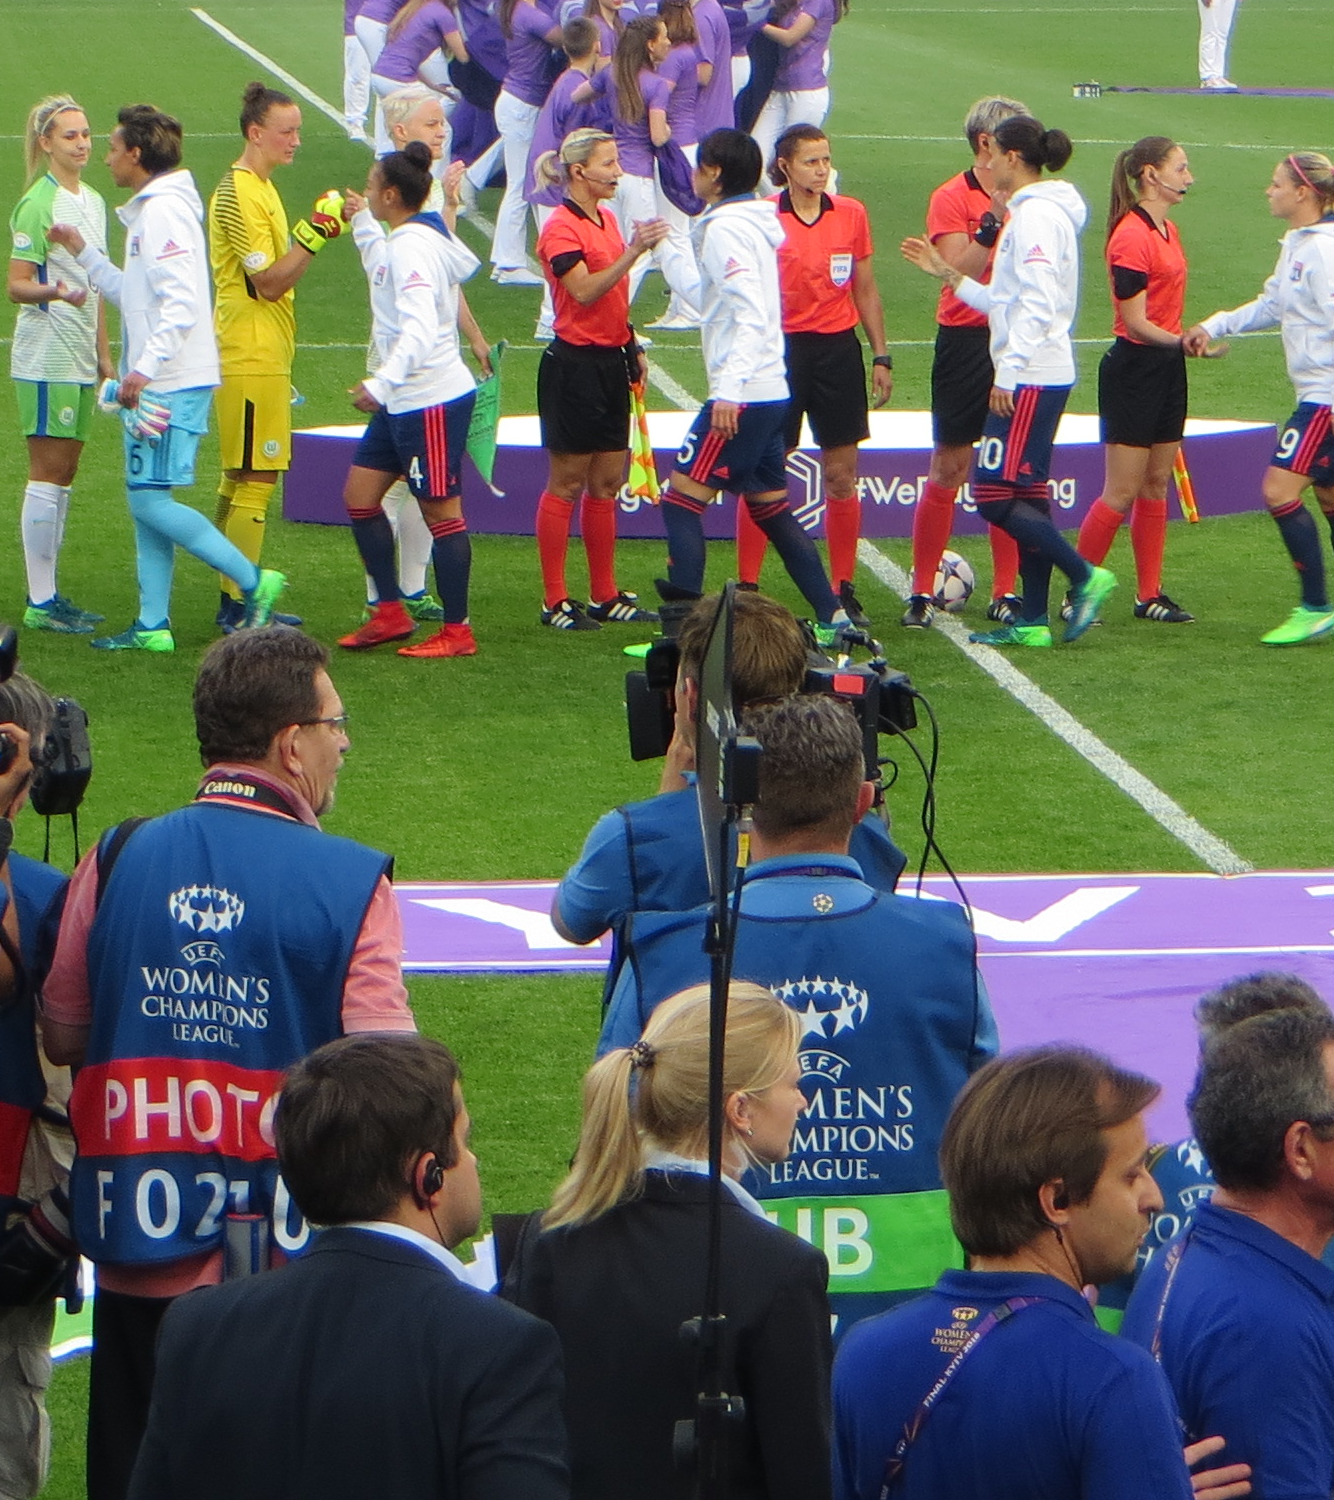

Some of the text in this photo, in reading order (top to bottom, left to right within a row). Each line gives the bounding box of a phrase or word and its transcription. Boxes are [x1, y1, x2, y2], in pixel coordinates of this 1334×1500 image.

[978, 436, 1004, 471] 10
[1279, 428, 1300, 462] 9
[408, 455, 424, 489] 4
[204, 780, 257, 798] Canon
[140, 995, 269, 1031] CHAMPIONS
[769, 1158, 869, 1184] LEAGUE
[922, 1377, 948, 1407] FINAL
[944, 1351, 964, 1377] KYIV
[963, 1332, 981, 1354] 2018
